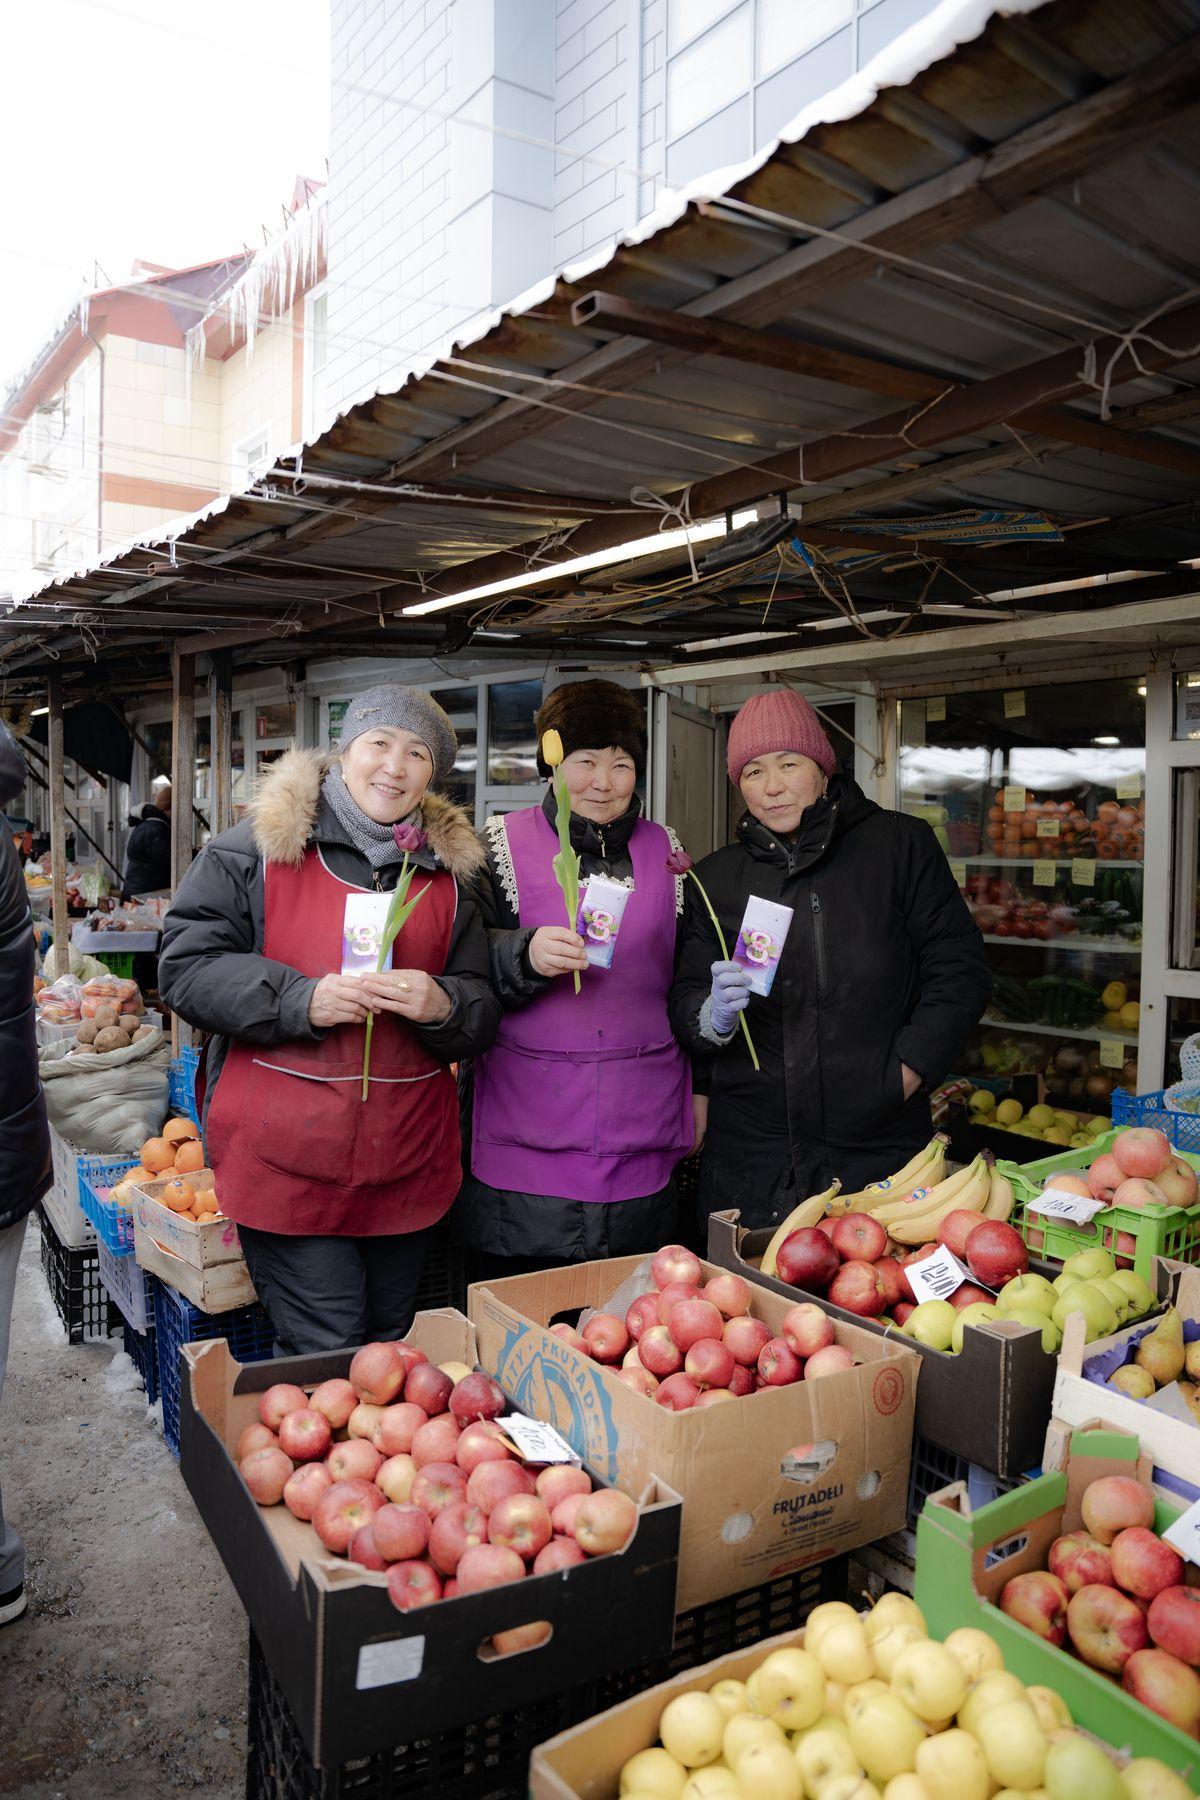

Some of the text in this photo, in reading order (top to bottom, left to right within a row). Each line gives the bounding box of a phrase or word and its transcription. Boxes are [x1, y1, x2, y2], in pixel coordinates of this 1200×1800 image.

[352, 924, 378, 957] 8
[586, 910, 614, 942] 8
[745, 931, 772, 964] 8
[772, 1483, 844, 1515] FRUTADELI
